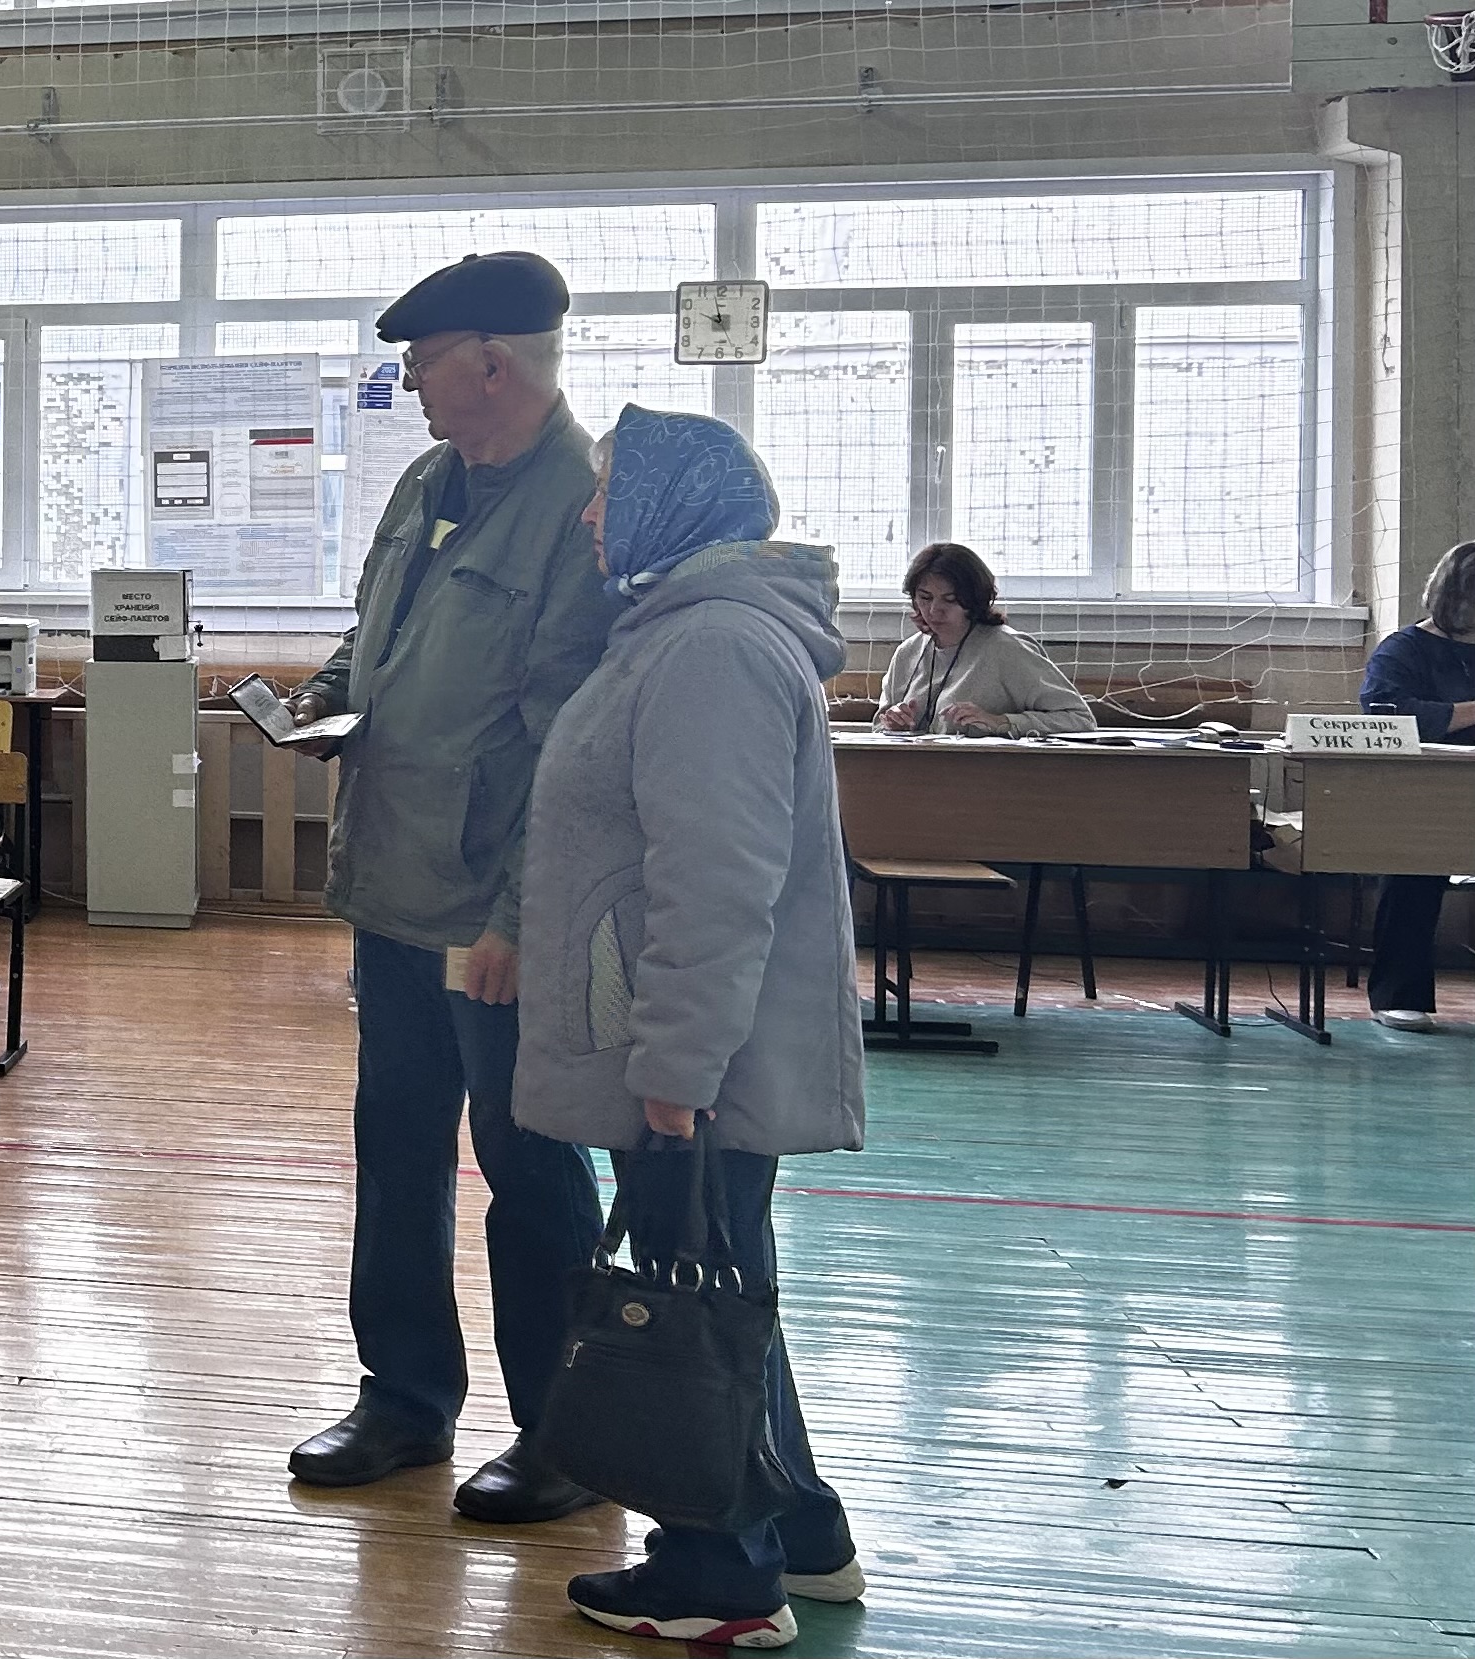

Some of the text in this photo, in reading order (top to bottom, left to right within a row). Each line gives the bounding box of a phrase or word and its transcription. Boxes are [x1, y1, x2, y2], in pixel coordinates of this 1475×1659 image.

[717, 286, 727, 297] 12
[751, 298, 760, 310] 2
[682, 317, 691, 329] 9
[751, 316, 760, 328] 3
[681, 335, 690, 347] 8
[750, 335, 759, 347] 4
[715, 347, 724, 359] 6
[735, 347, 743, 359] 5
[104, 614, 170, 622] СЕЙФ-ПАКЕТОВ
[1309, 717, 1398, 732] Секретарь
[1310, 735, 1403, 749] УИК 1479
